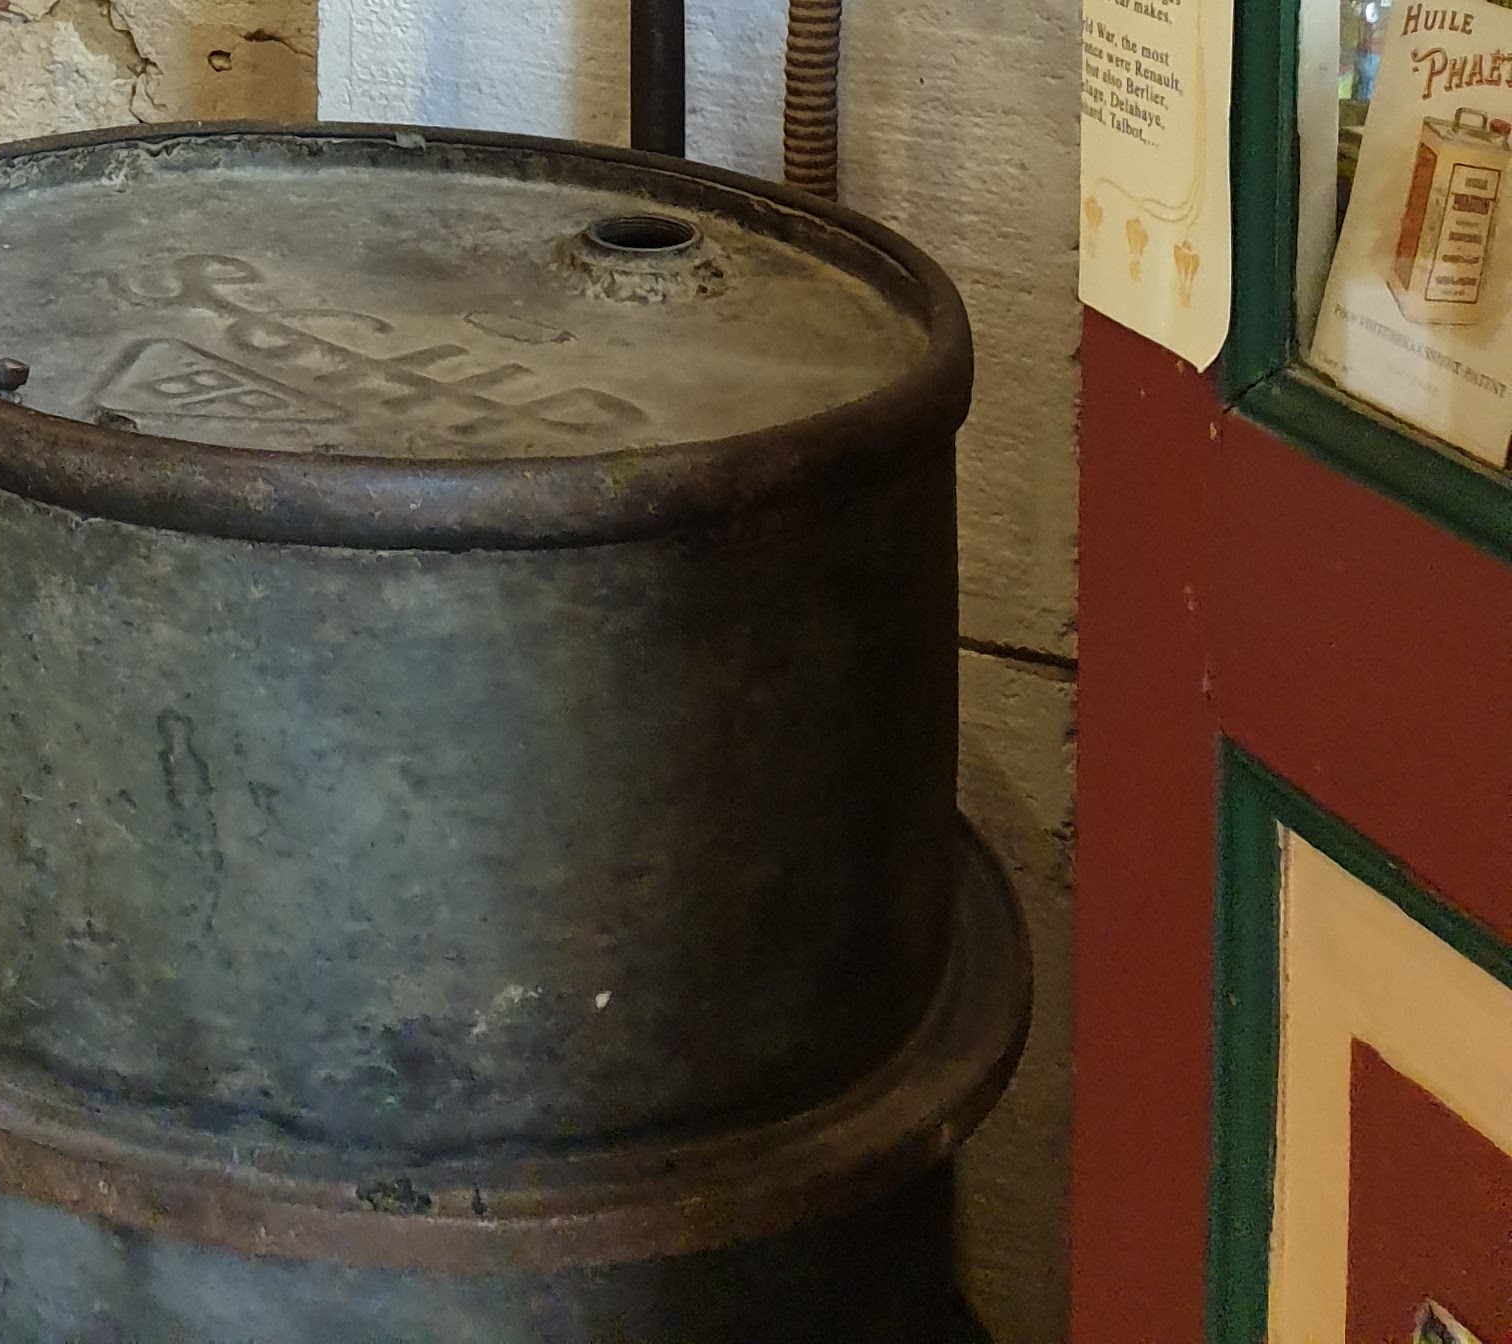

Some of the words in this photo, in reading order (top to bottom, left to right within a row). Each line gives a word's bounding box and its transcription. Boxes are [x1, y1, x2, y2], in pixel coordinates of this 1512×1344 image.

[1134, 1, 1172, 24] makes.
[1400, 3, 1475, 37] HUILE
[1122, 34, 1137, 53] the
[1142, 45, 1169, 67] most
[1102, 69, 1122, 89] also
[1135, 59, 1183, 97] Renault,
[1110, 91, 1165, 130] Delahaye,
